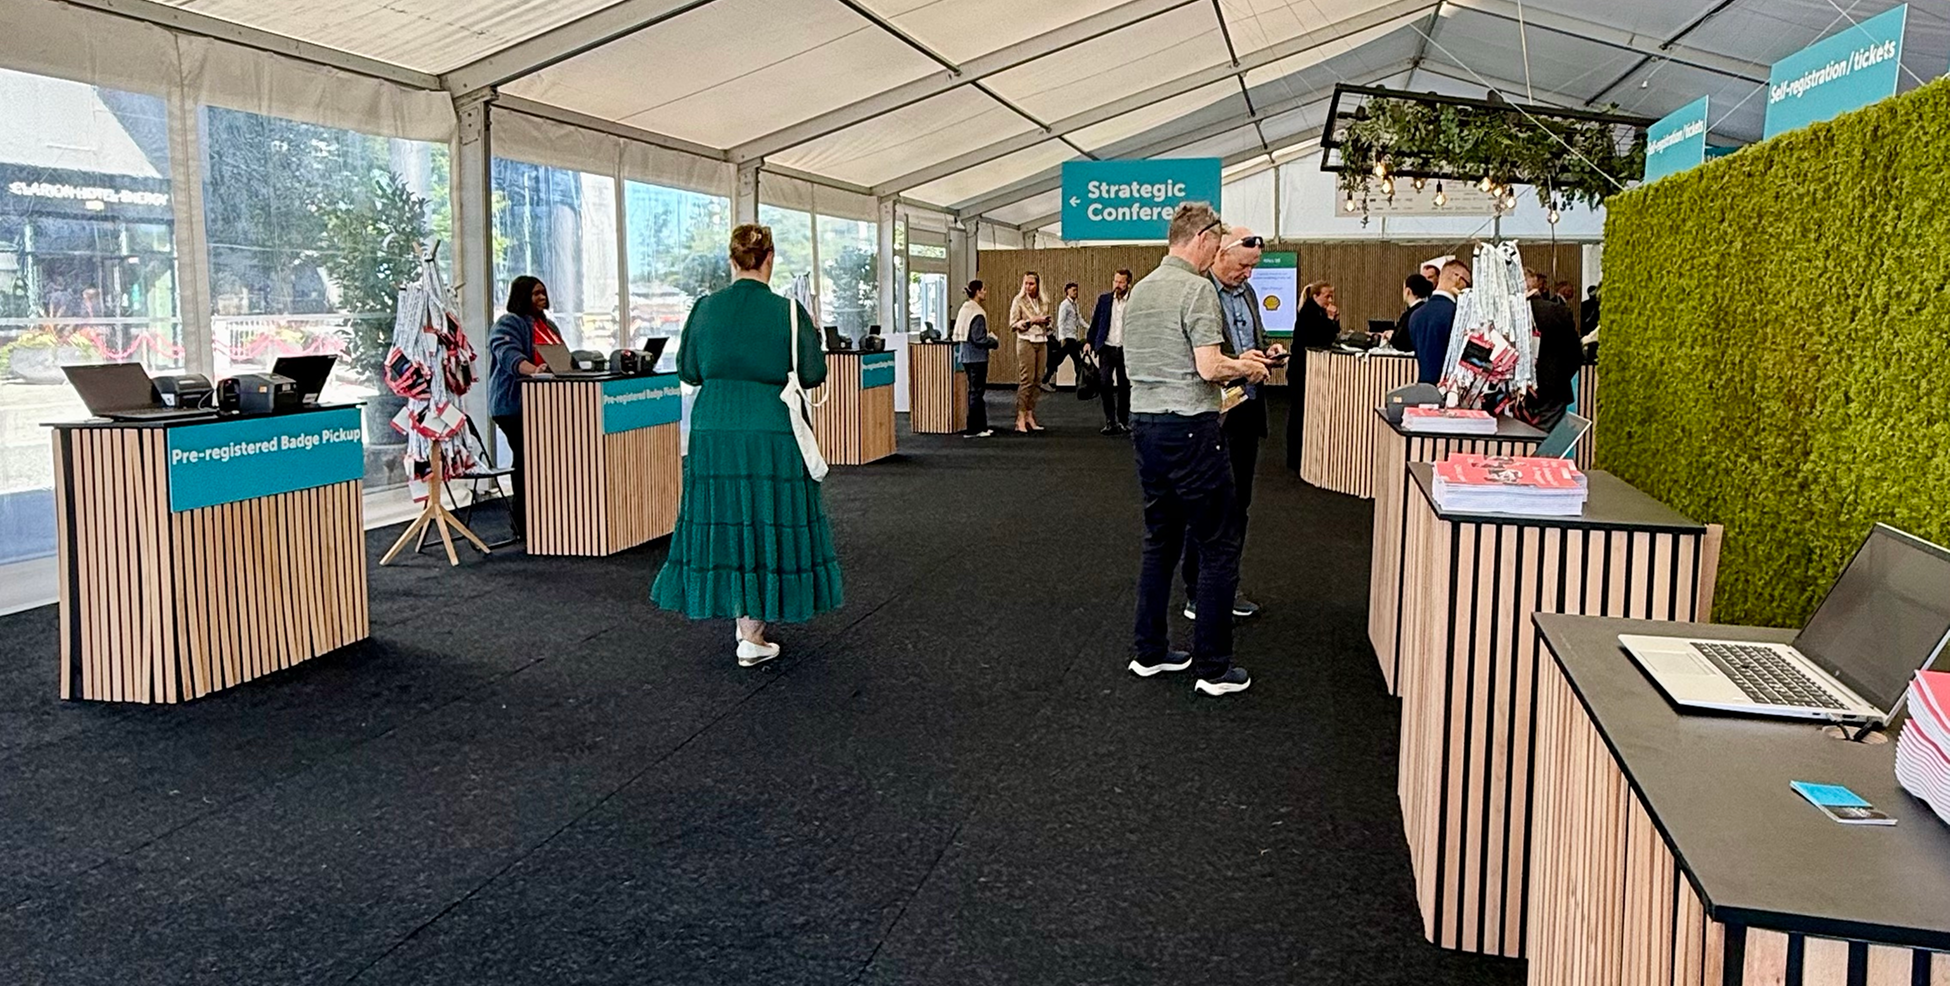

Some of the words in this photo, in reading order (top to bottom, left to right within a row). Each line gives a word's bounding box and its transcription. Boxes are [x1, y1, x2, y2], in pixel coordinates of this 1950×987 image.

[1087, 179, 1186, 201] Strategic
[1087, 203, 1177, 221] Confere
[172, 437, 278, 465] Pre-registered
[281, 433, 320, 450] Badge
[322, 427, 361, 443] Pickup
